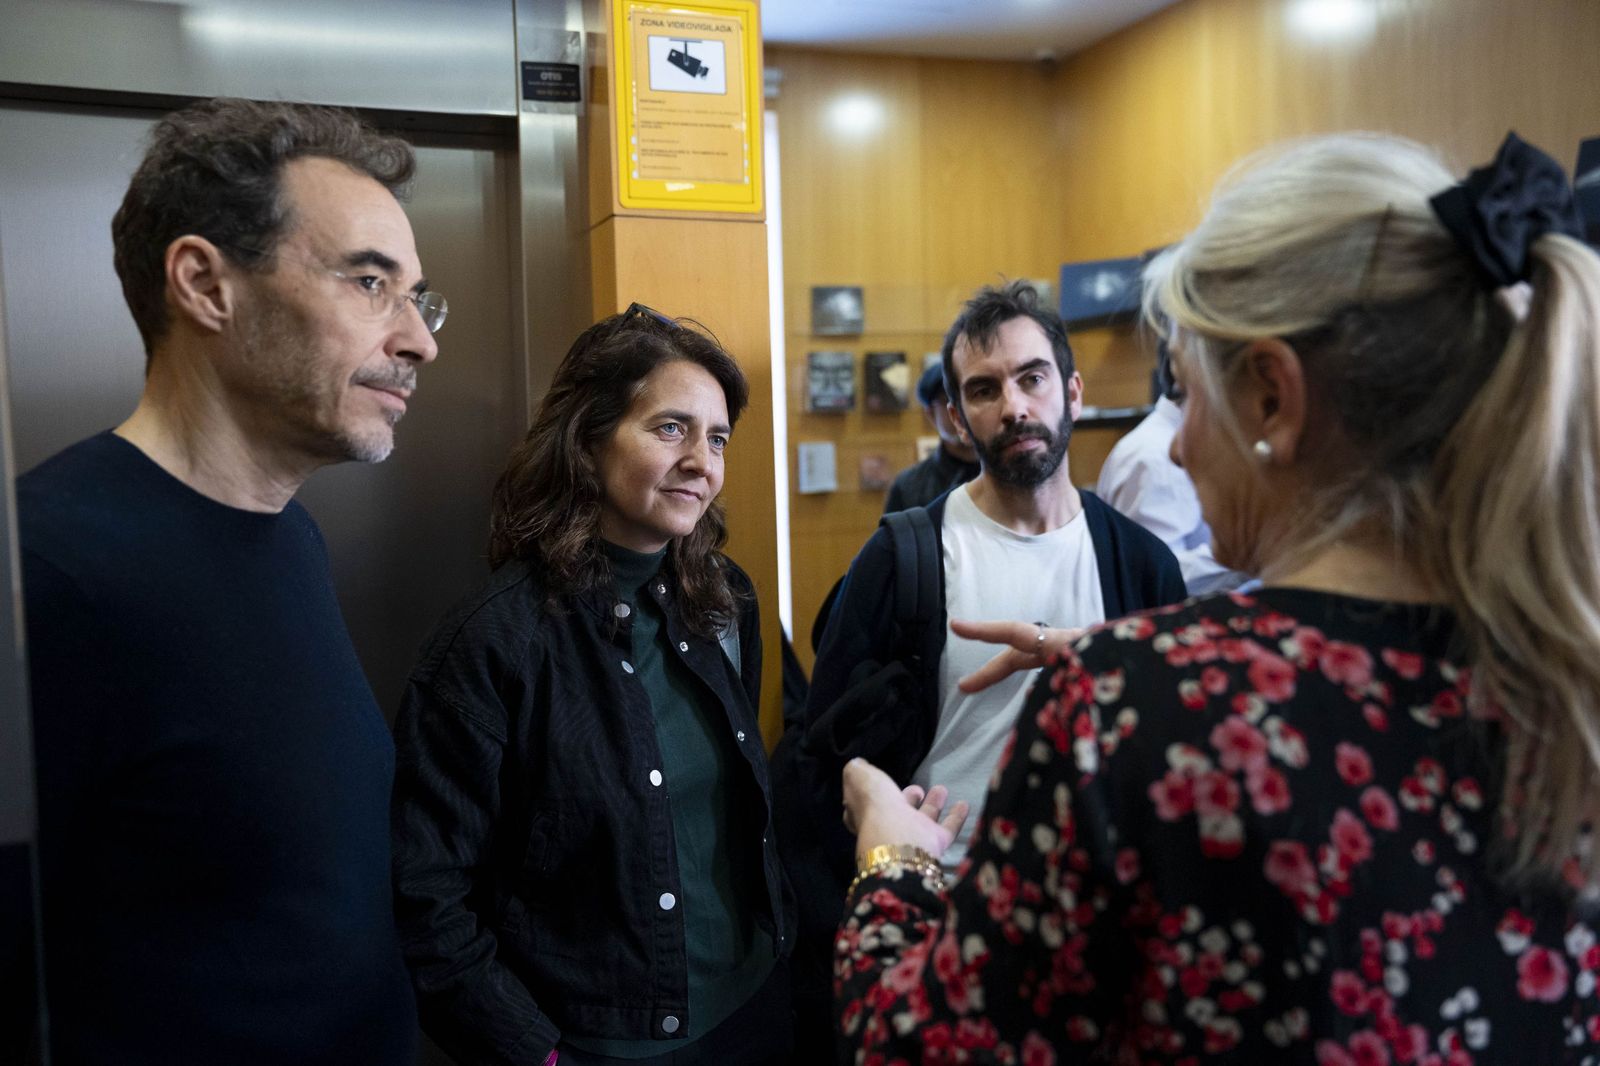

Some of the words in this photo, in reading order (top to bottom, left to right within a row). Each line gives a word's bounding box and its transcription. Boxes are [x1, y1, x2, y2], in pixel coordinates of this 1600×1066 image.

[640, 18, 664, 28] ZONA
[667, 20, 733, 33] VIDEOVIGILADA
[540, 72, 563, 81] OTIS
